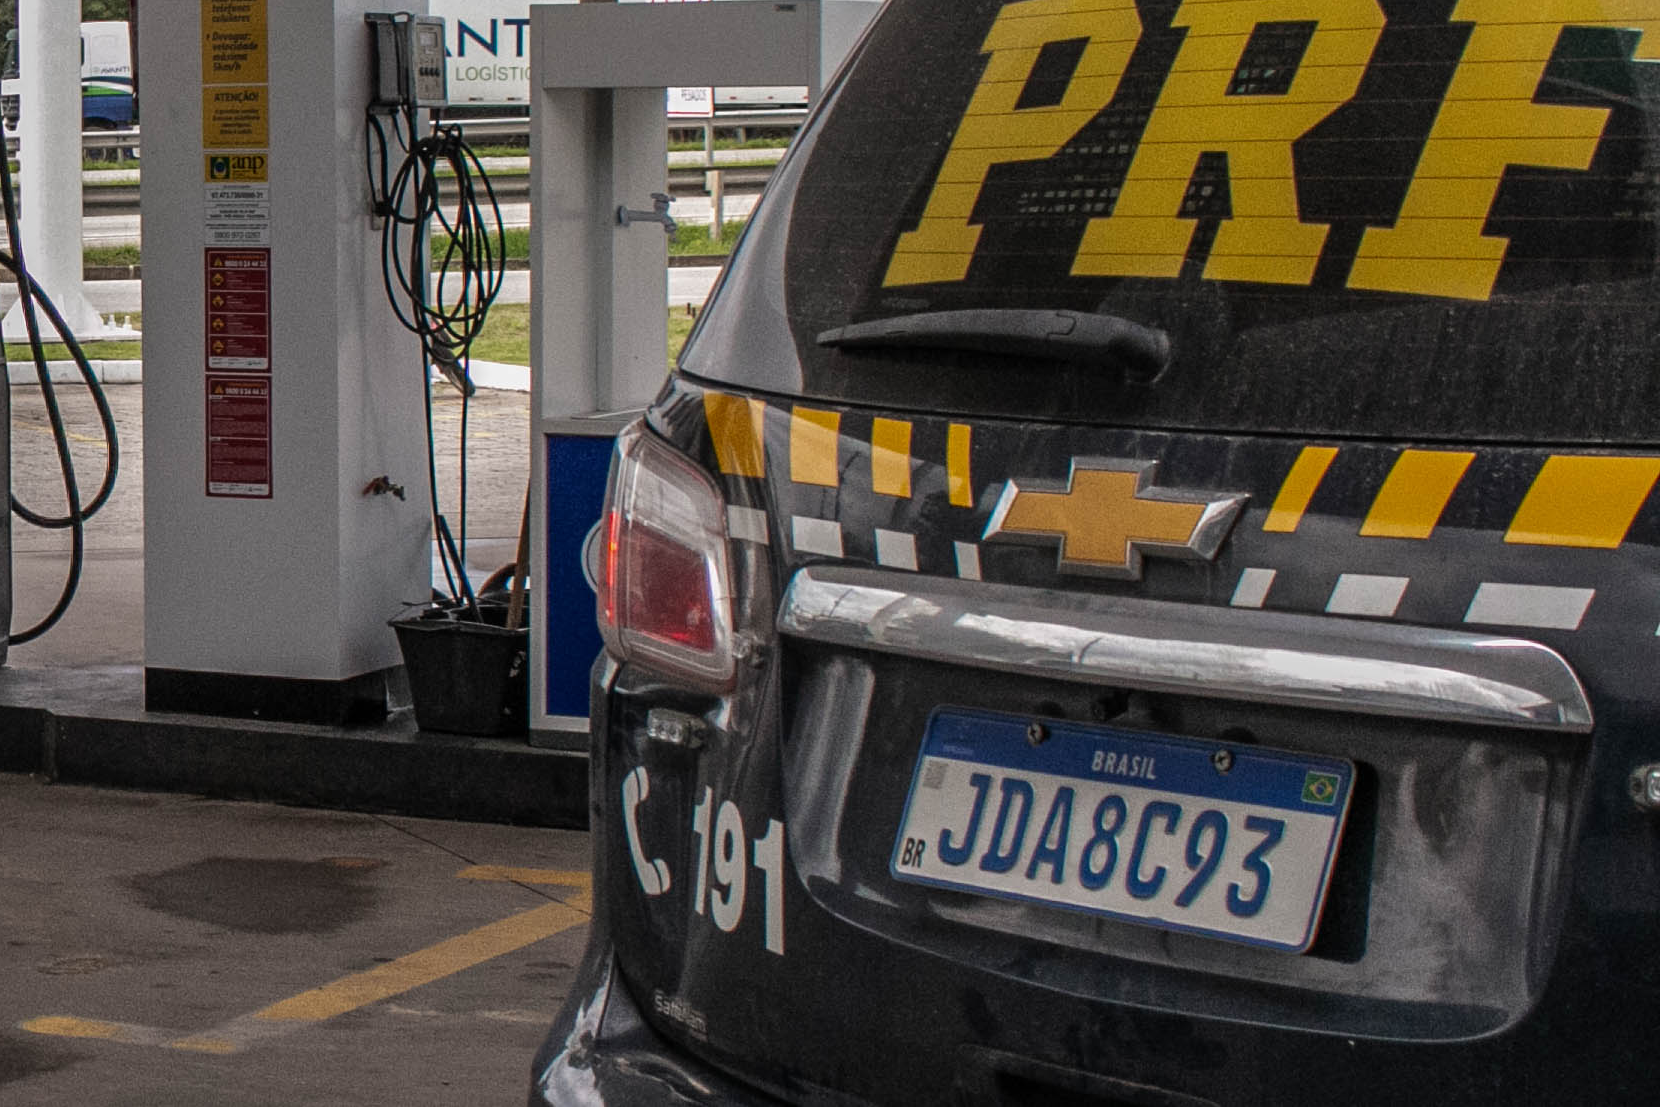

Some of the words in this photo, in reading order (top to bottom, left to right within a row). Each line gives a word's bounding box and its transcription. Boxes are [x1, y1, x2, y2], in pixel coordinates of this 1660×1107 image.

[444, 18, 531, 58] NT
[232, 155, 264, 173] anp
[1091, 749, 1157, 781] BRASIL
[901, 837, 926, 869] BR
[937, 772, 1286, 919] JDA8C93
[693, 785, 786, 956] 191
